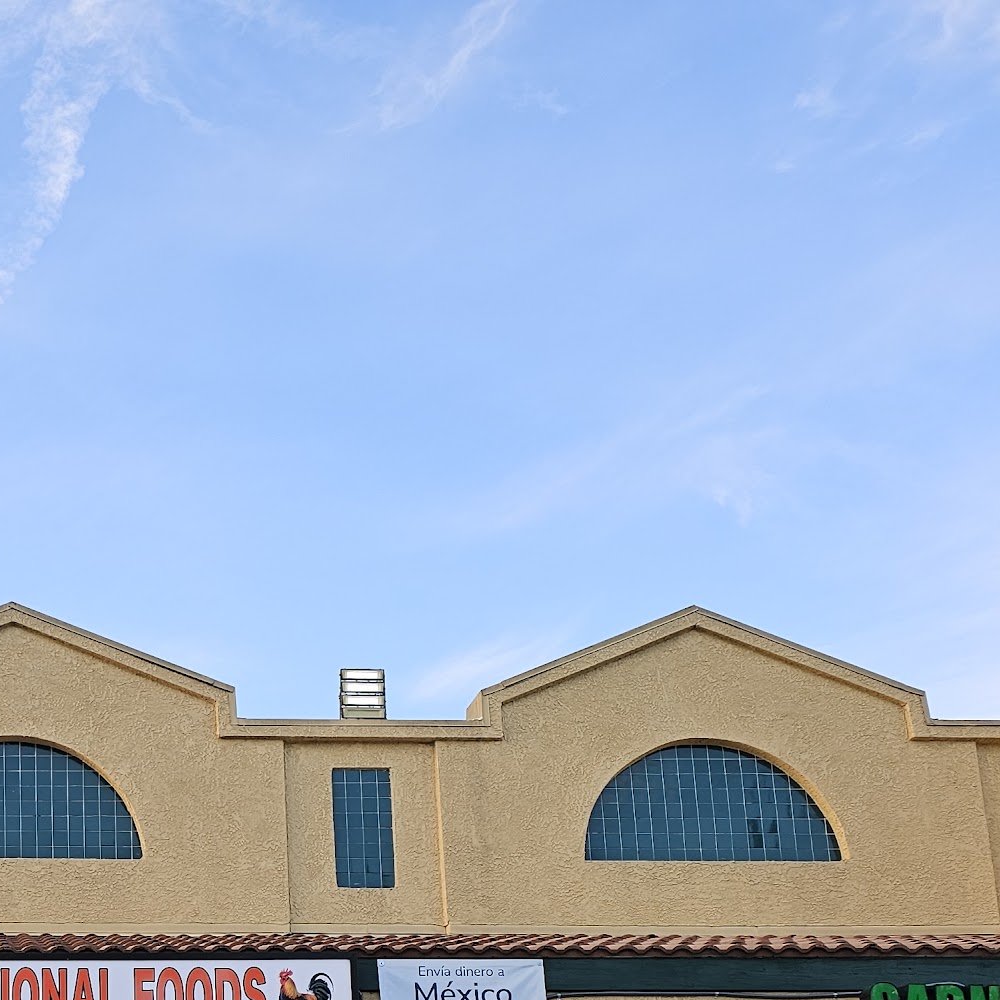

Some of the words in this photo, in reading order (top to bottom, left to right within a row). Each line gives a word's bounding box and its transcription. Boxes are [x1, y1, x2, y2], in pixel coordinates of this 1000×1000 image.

[418, 965, 451, 977] Envía
[455, 965, 494, 977] dinero
[497, 968, 505, 977] a
